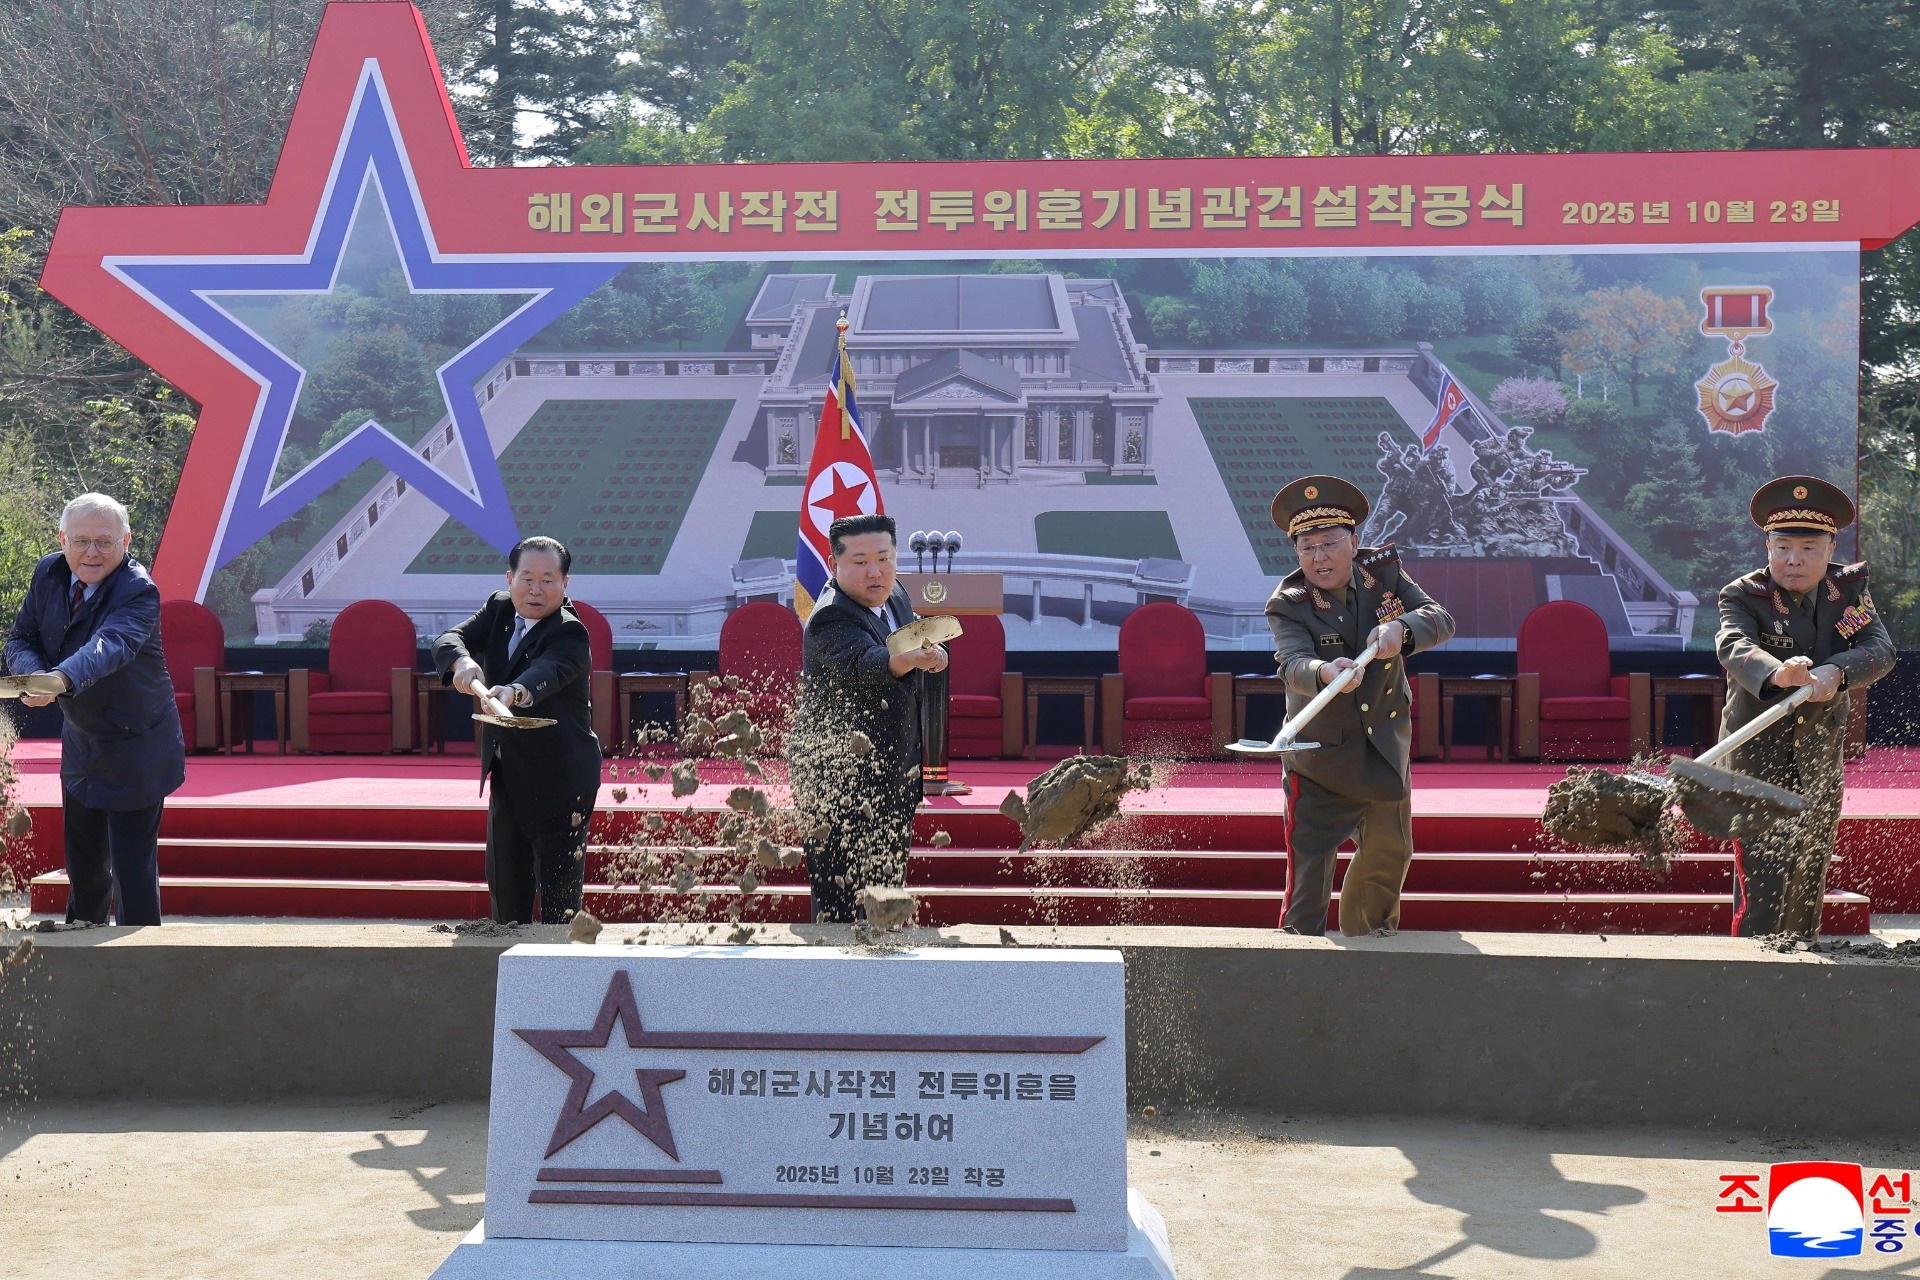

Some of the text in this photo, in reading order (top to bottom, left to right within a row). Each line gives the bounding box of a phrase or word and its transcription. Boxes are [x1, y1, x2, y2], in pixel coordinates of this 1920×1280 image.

[527, 183, 1525, 234] 해외군사작전 전투위훈기념관건설착공식
[1561, 198, 1841, 225] 2025년 10월 23일
[707, 1067, 1078, 1101] 해외군사작전 전투위훈을
[827, 1111, 954, 1143] 기념하여
[775, 1163, 1007, 1188] 2025년 10월 23일 착공
